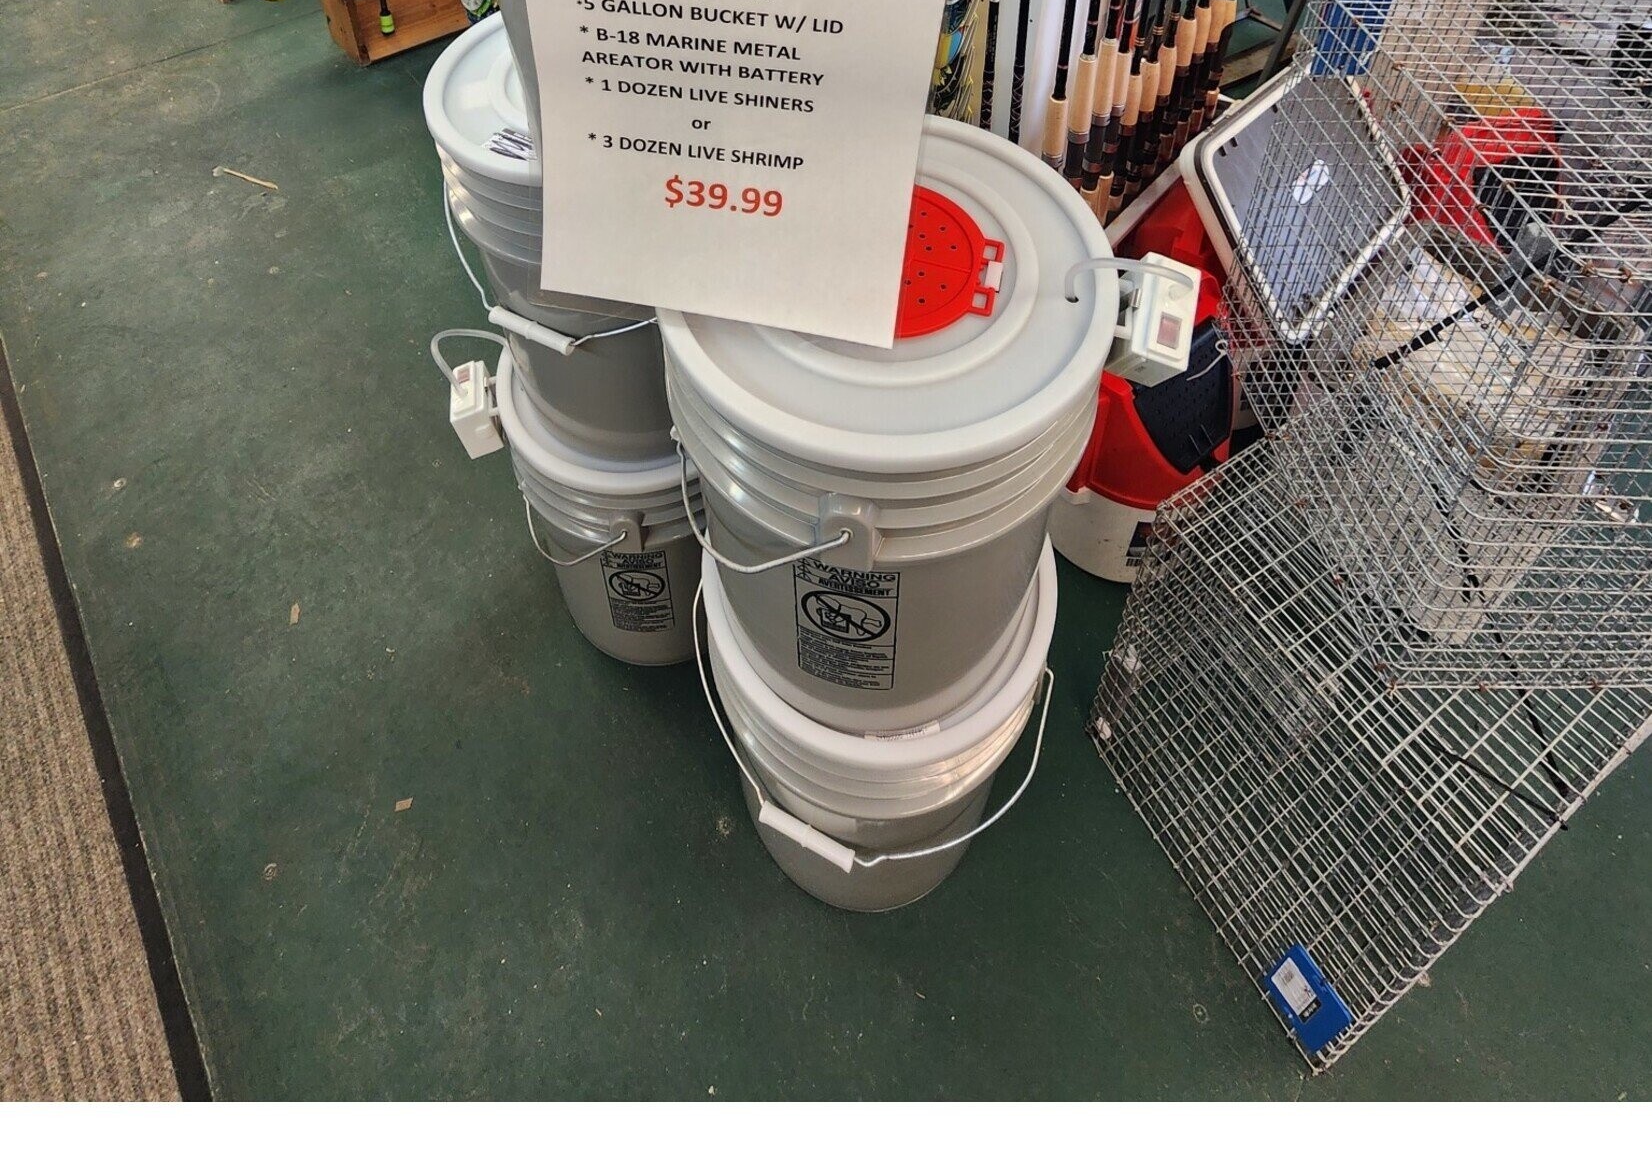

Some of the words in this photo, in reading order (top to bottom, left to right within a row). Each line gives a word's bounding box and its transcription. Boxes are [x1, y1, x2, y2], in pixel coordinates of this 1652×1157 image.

[690, 7, 769, 28] BUCKET
[775, 14, 806, 33] W/
[812, 19, 844, 34] LID
[596, 28, 640, 45] B-18
[646, 33, 727, 54] MARINE
[734, 42, 801, 61] METAL
[581, 50, 673, 71] AREATOR
[680, 61, 732, 78] WITH
[738, 66, 824, 86] BATTERY
[601, 79, 612, 92] 1
[617, 80, 683, 99] DOZEN
[689, 88, 728, 104] LIVE
[734, 93, 814, 113] SHINERS
[692, 119, 711, 130] or
[602, 135, 613, 148] 3
[619, 136, 682, 156] DOZEN
[688, 146, 725, 161] LIVE
[731, 150, 804, 170] SHRIMP
[664, 175, 783, 217] $39.99
[813, 560, 896, 582] WARNING
[829, 573, 880, 589] AVISO
